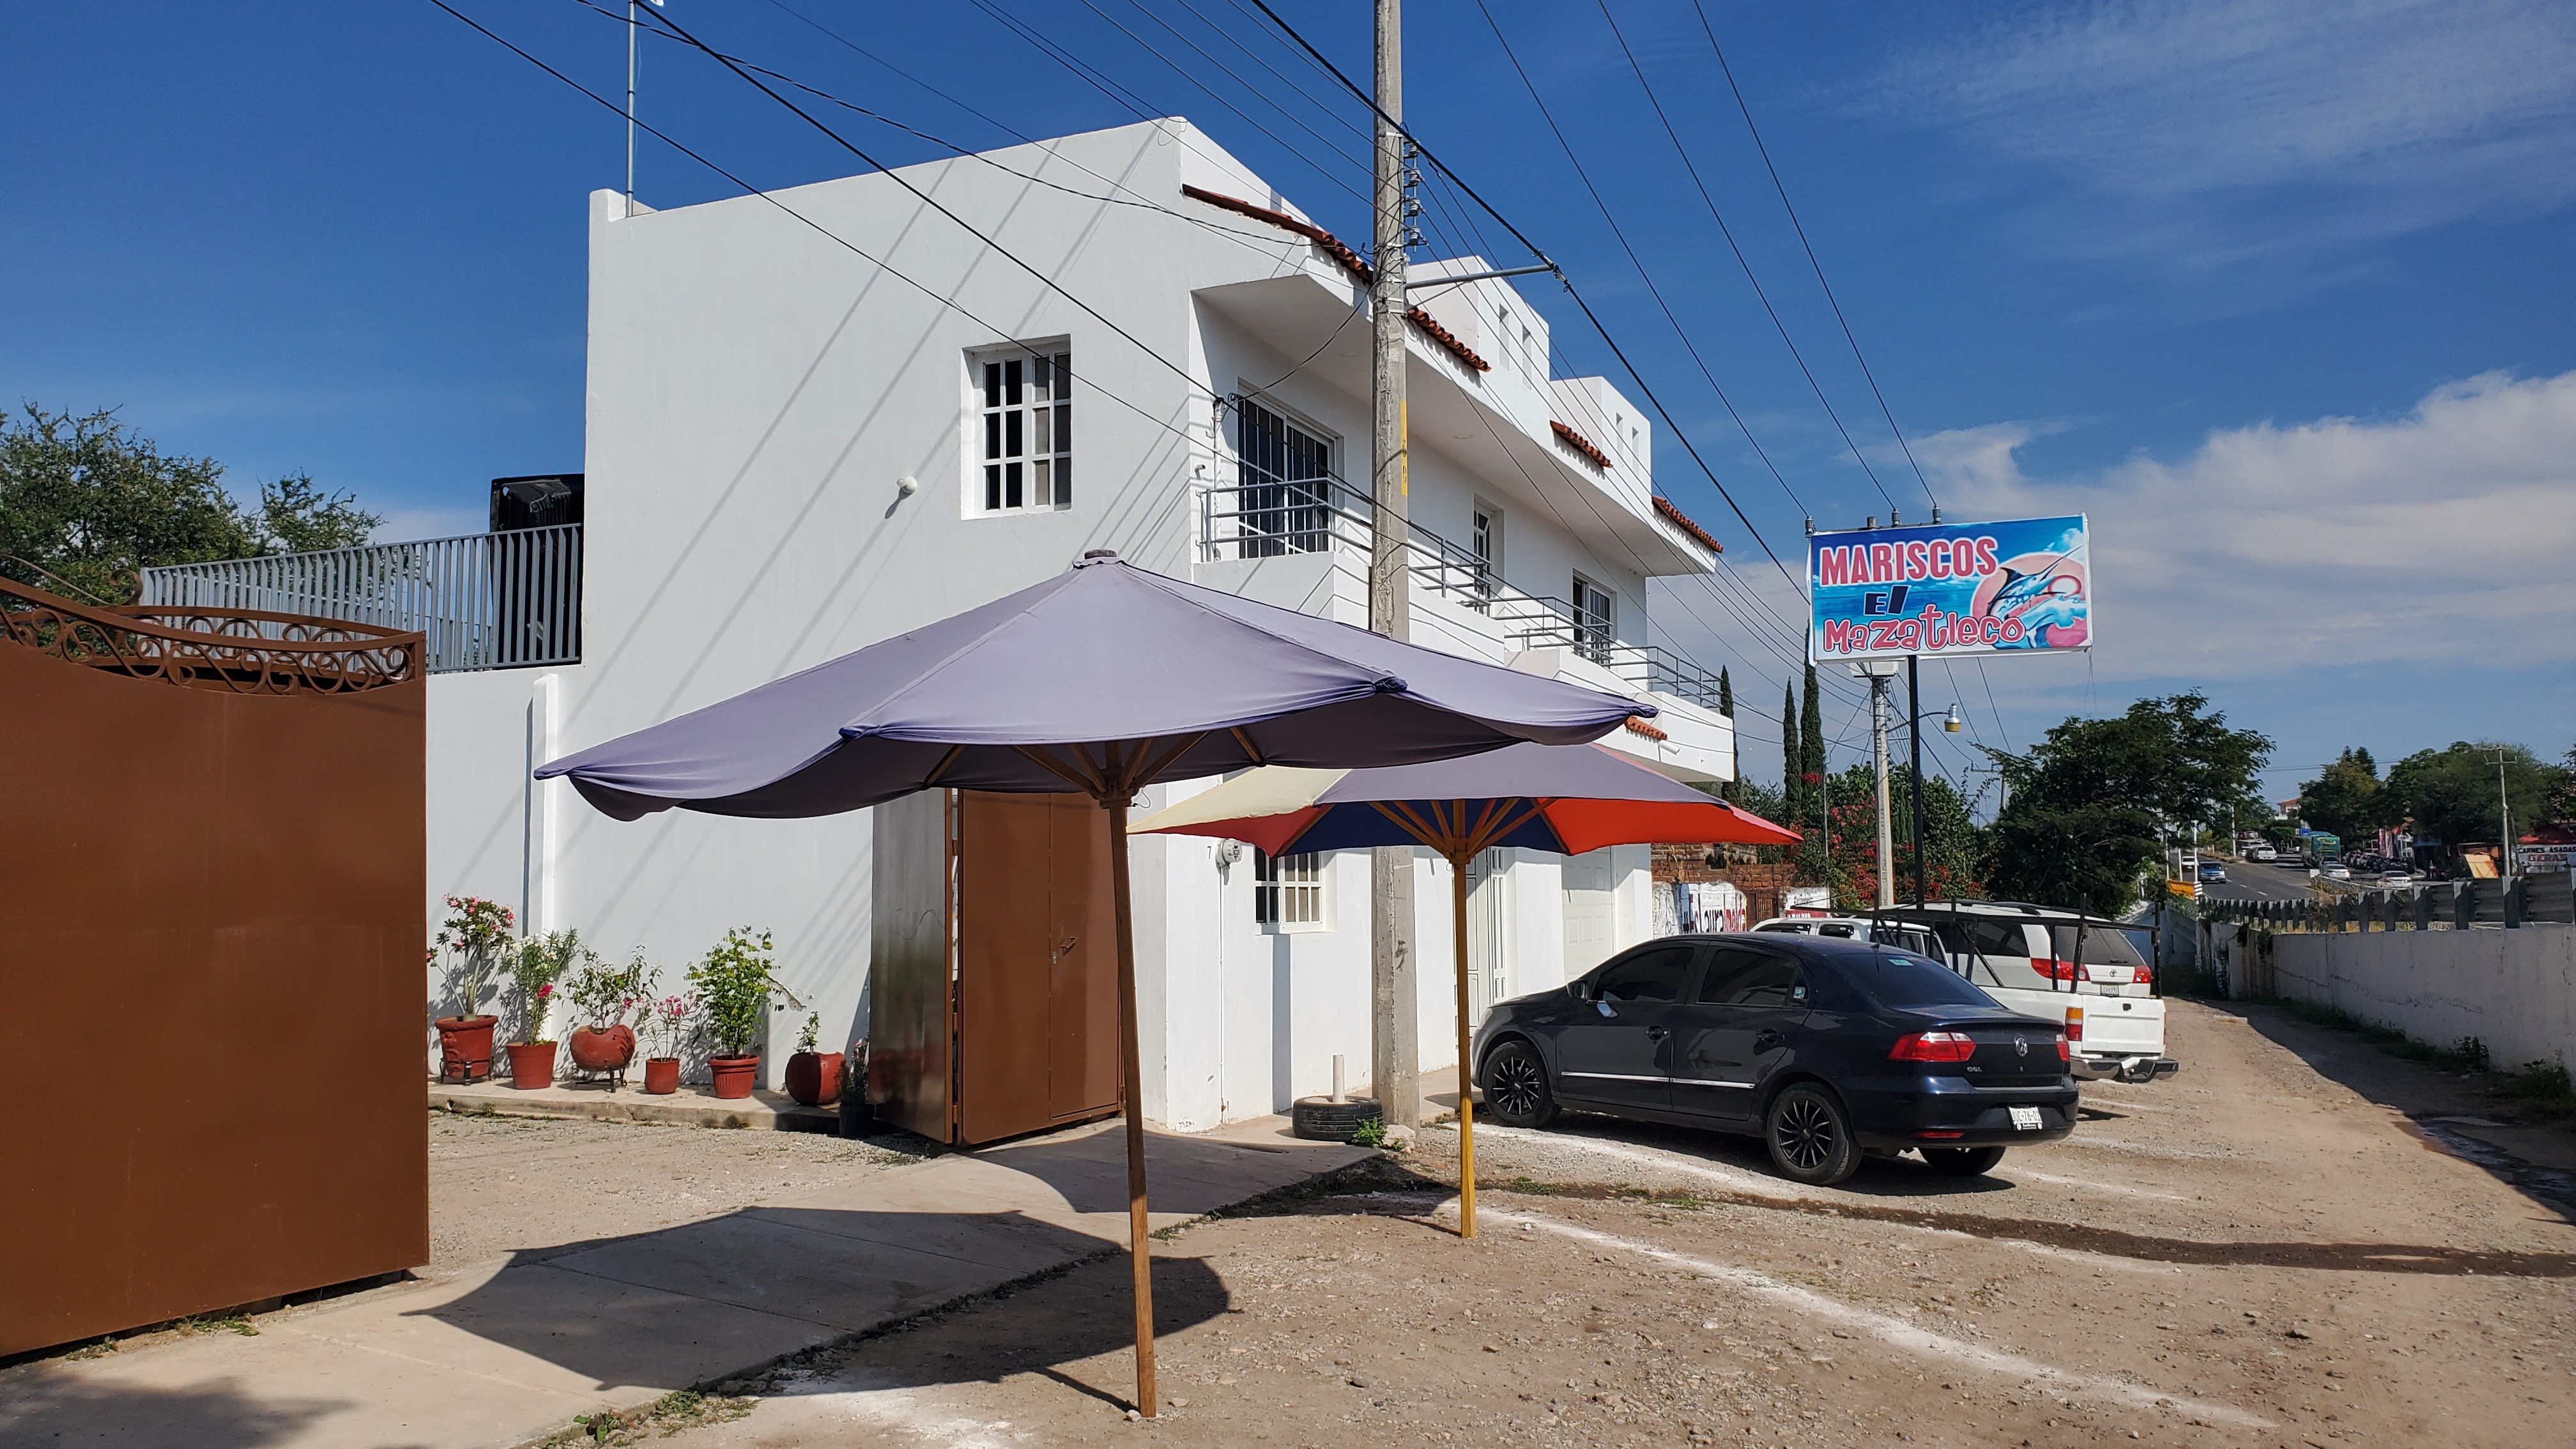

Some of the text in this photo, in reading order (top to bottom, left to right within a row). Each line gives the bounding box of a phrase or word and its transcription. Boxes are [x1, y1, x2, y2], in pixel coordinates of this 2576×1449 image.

[1821, 538, 1997, 585] MARISCOS
[1865, 585, 1909, 615] El
[1824, 604, 2024, 654] Mazatleco
